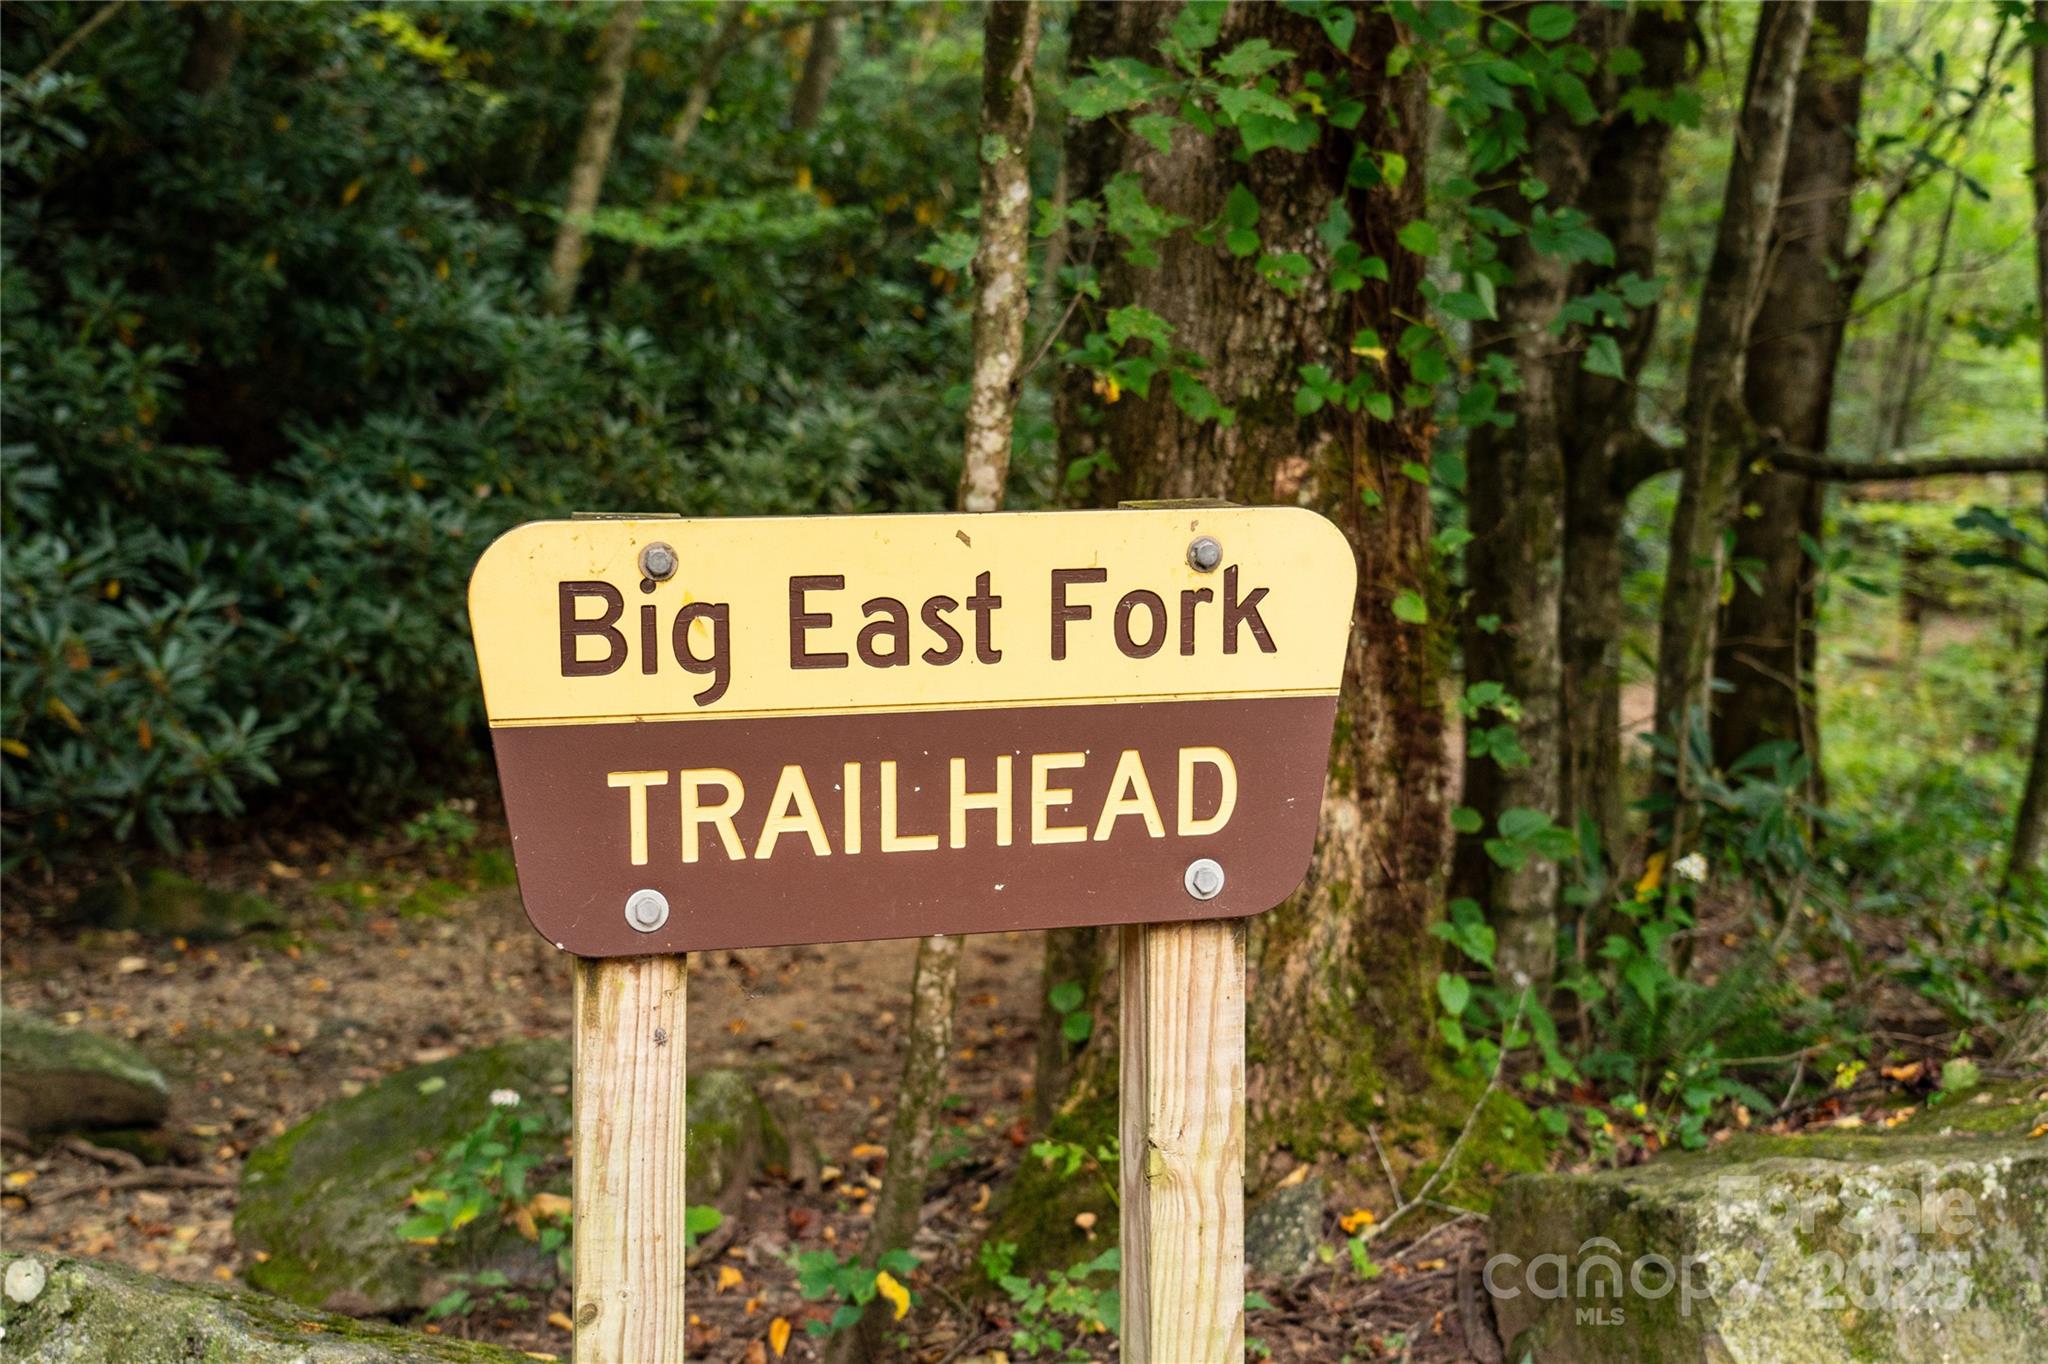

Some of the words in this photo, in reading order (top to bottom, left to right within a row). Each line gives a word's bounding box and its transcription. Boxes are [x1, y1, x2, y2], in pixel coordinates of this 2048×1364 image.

[557, 576, 731, 707] Big
[788, 570, 1003, 671] East
[1050, 564, 1279, 662] Fork
[606, 746, 1240, 866] TRAILHEAD
